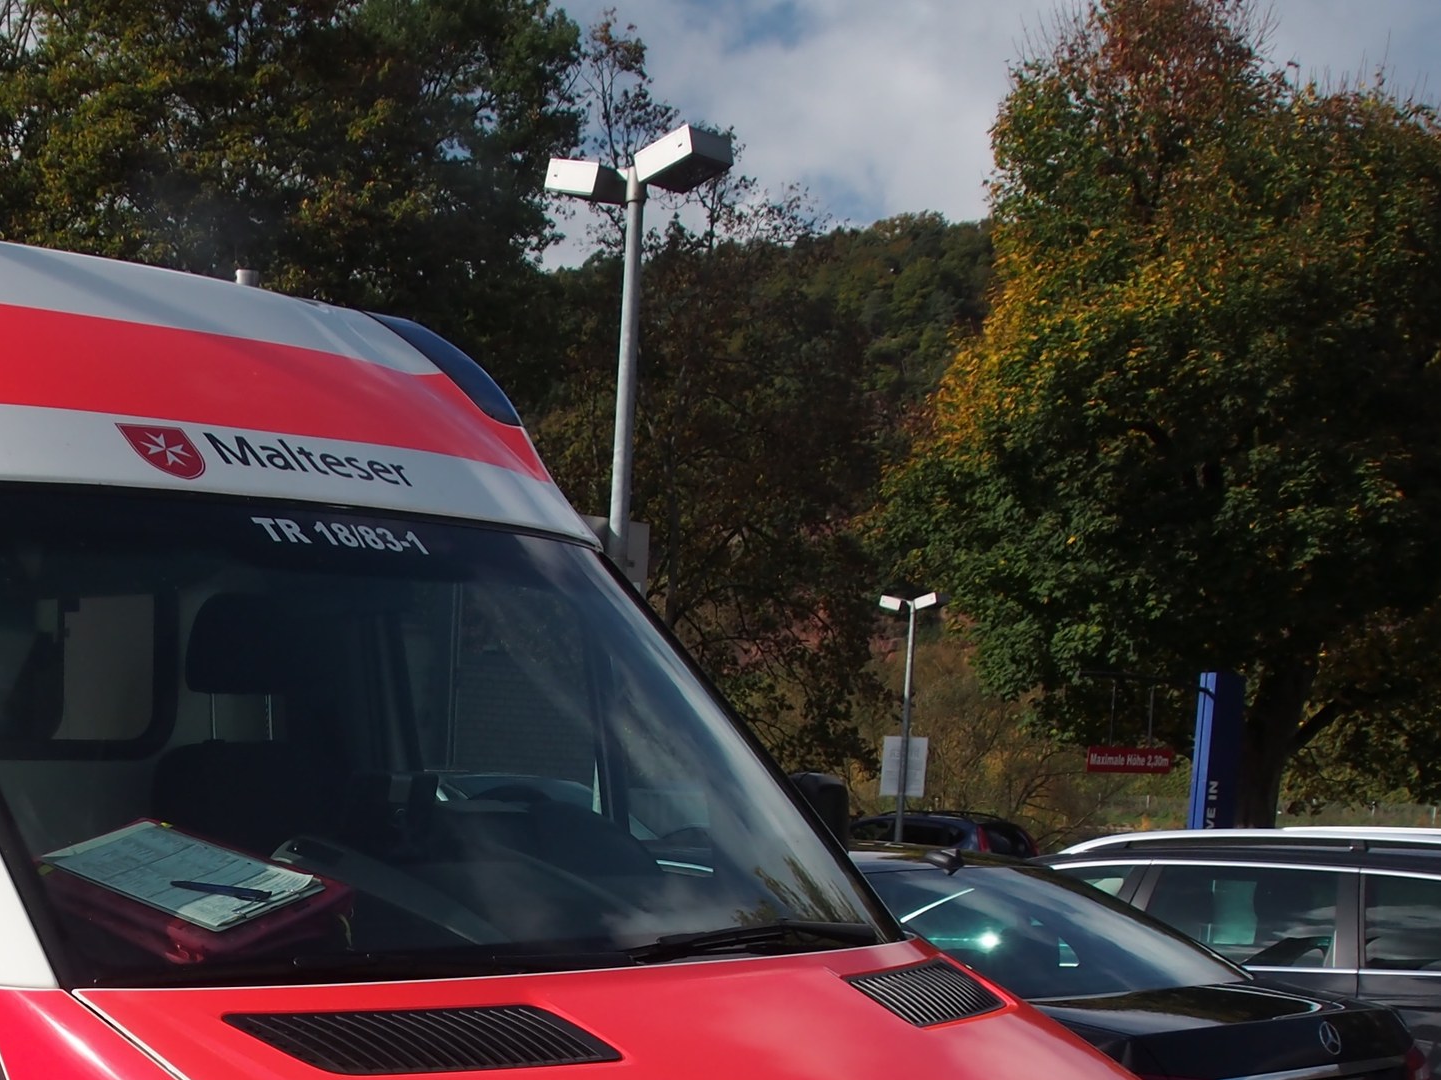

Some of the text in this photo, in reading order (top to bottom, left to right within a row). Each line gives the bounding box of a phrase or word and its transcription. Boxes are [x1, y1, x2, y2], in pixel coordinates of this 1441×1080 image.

[203, 432, 413, 487] Malteser
[250, 516, 430, 555] TR 18/83-1
[1090, 752, 1125, 766] Maximale
[1126, 753, 1146, 767] Höhe
[1207, 781, 1219, 800] IN
